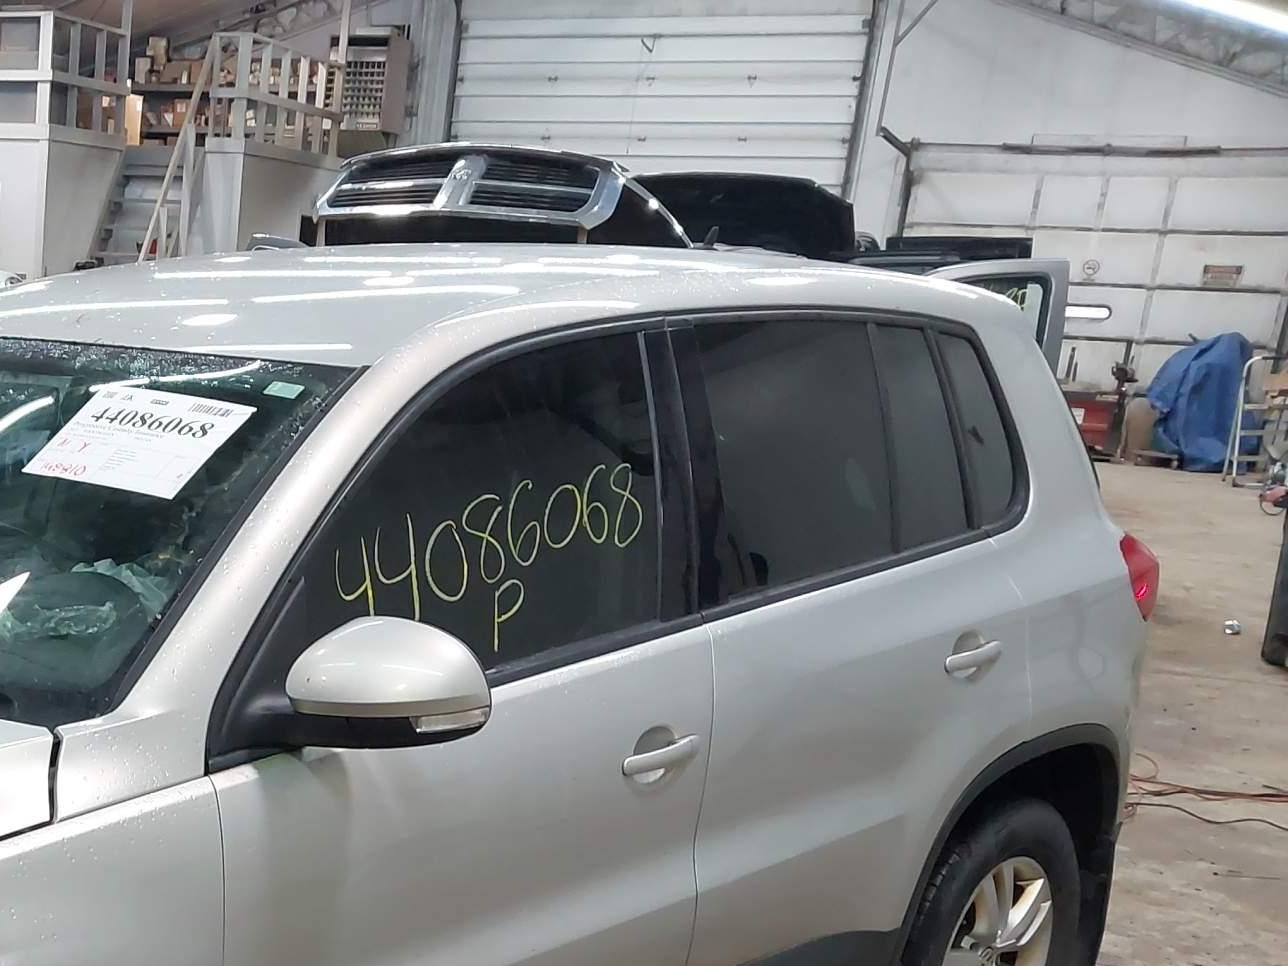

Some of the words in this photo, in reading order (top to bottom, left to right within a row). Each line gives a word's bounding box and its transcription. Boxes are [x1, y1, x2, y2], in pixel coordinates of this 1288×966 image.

[90, 406, 215, 439] 44086068
[334, 462, 644, 622] 44086068
[492, 578, 525, 652] P
